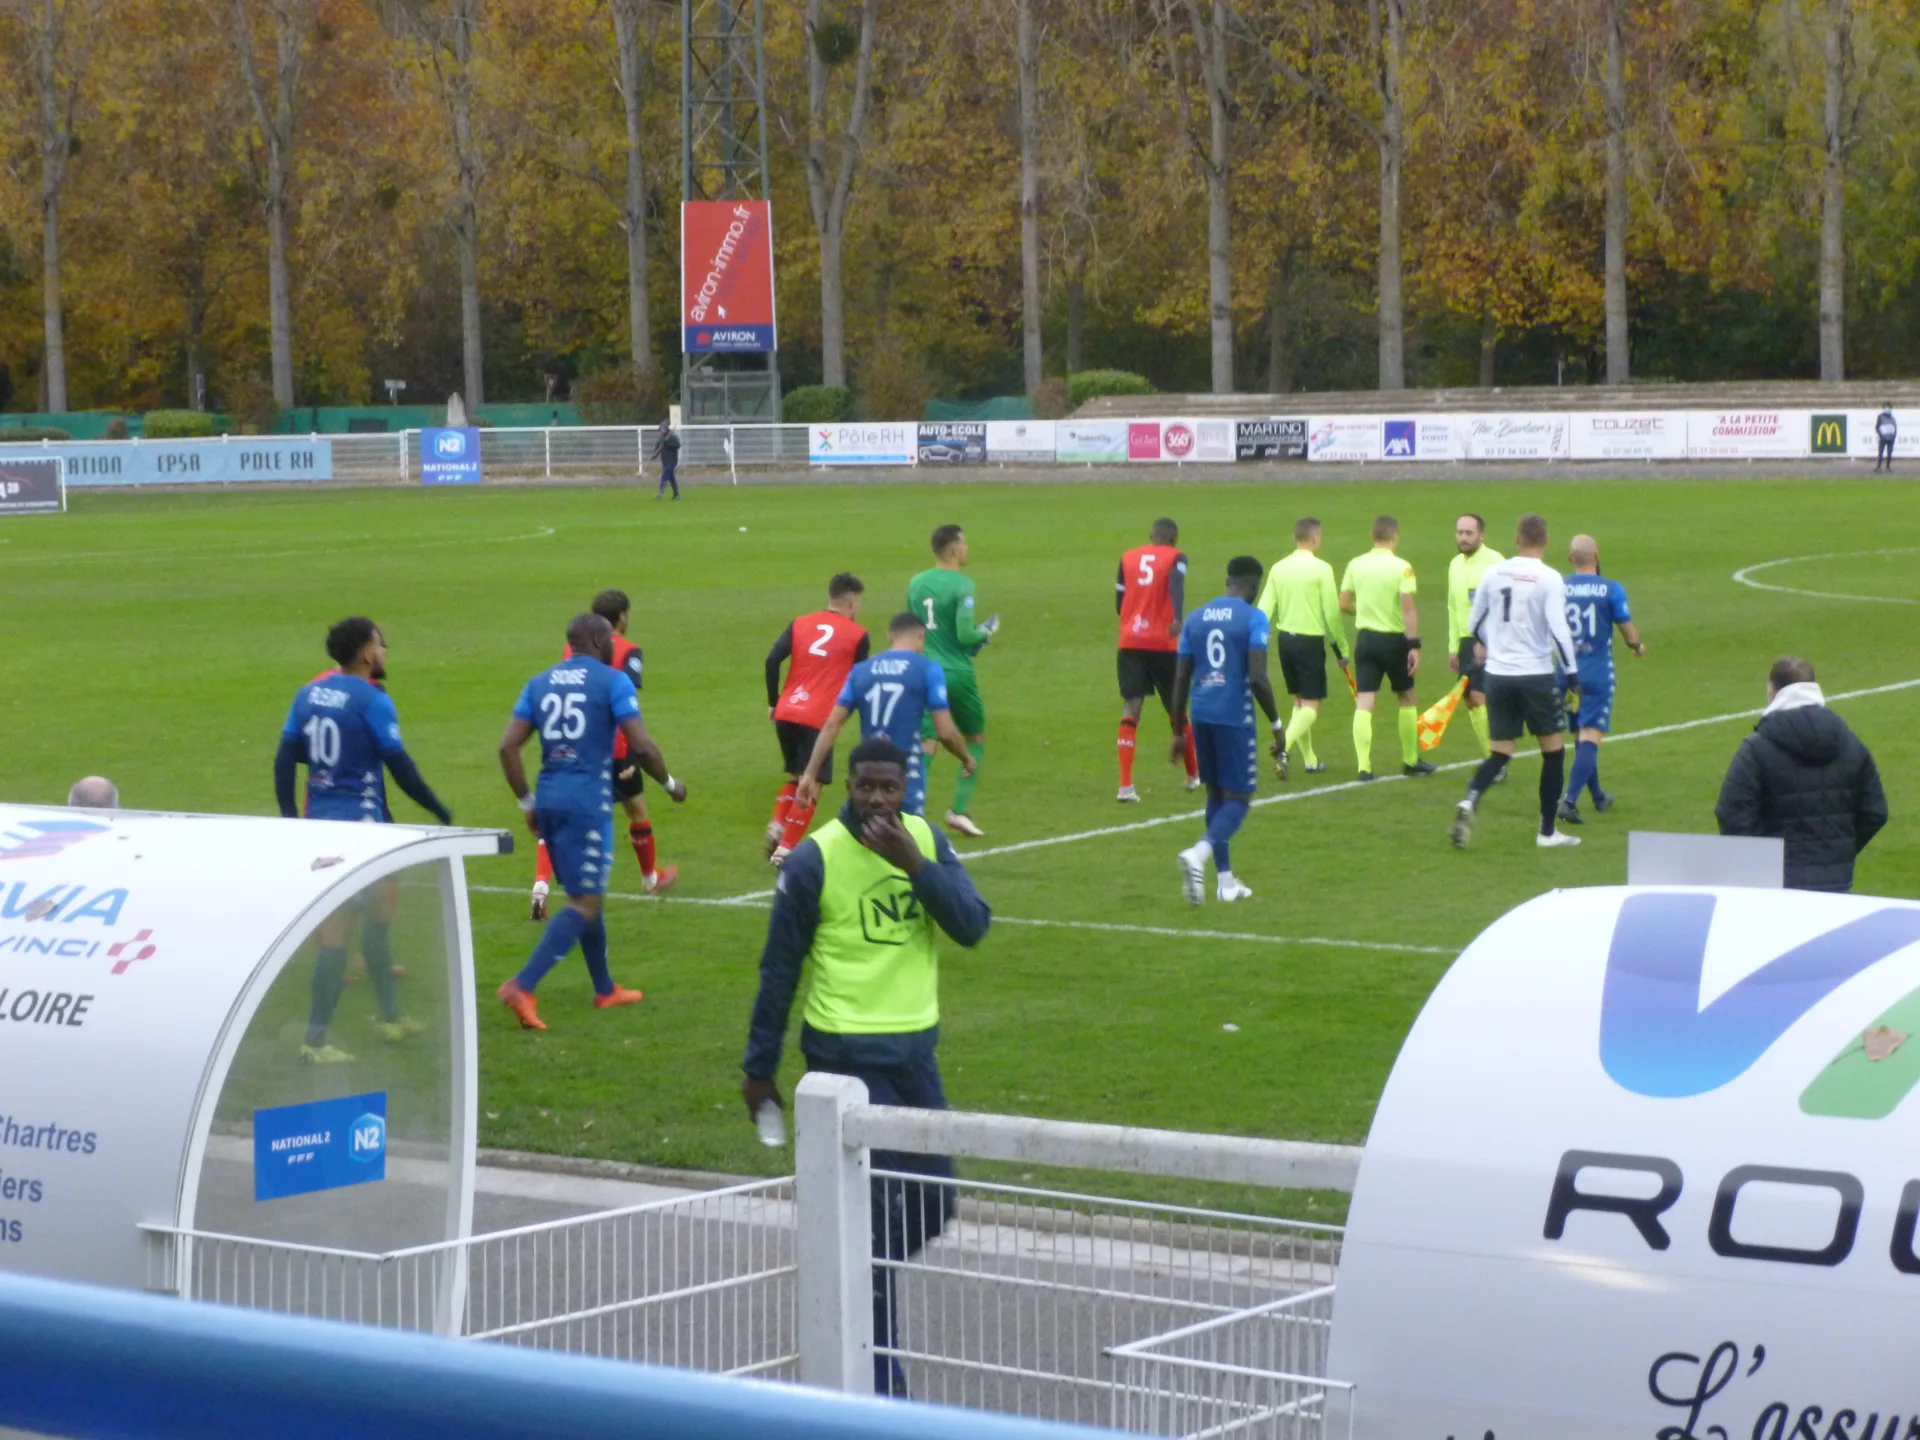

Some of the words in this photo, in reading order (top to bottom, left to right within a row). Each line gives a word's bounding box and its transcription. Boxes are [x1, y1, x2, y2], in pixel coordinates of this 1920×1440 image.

[690, 203, 751, 322] aviron-immo.fr
[713, 331, 756, 342] AVIRON
[1240, 422, 1301, 435] MARTINO
[1730, 414, 1741, 424] LA
[1745, 414, 1779, 424] PETITE
[69, 456, 122, 474] ATION
[241, 452, 282, 470] POLE
[291, 452, 314, 469] RH
[1385, 438, 1411, 454] AXA
[423, 462, 469, 472] NATIONAL
[1137, 554, 1156, 586] 5
[922, 597, 937, 630] 1
[1500, 587, 1513, 622] 1
[1565, 603, 1596, 638] 31
[808, 624, 834, 657] 2
[1206, 628, 1226, 668] 6
[541, 693, 587, 740] 25
[864, 682, 905, 727] 17
[304, 715, 340, 767] 10
[0, 881, 129, 926] VIA
[870, 891, 921, 928] N2
[0, 1115, 97, 1154] hartres
[271, 1132, 323, 1152] NATIONAL
[324, 1131, 331, 1143] 2
[354, 1126, 380, 1152] N2
[0, 1168, 42, 1202] ers
[1543, 1149, 1920, 1274] RO
